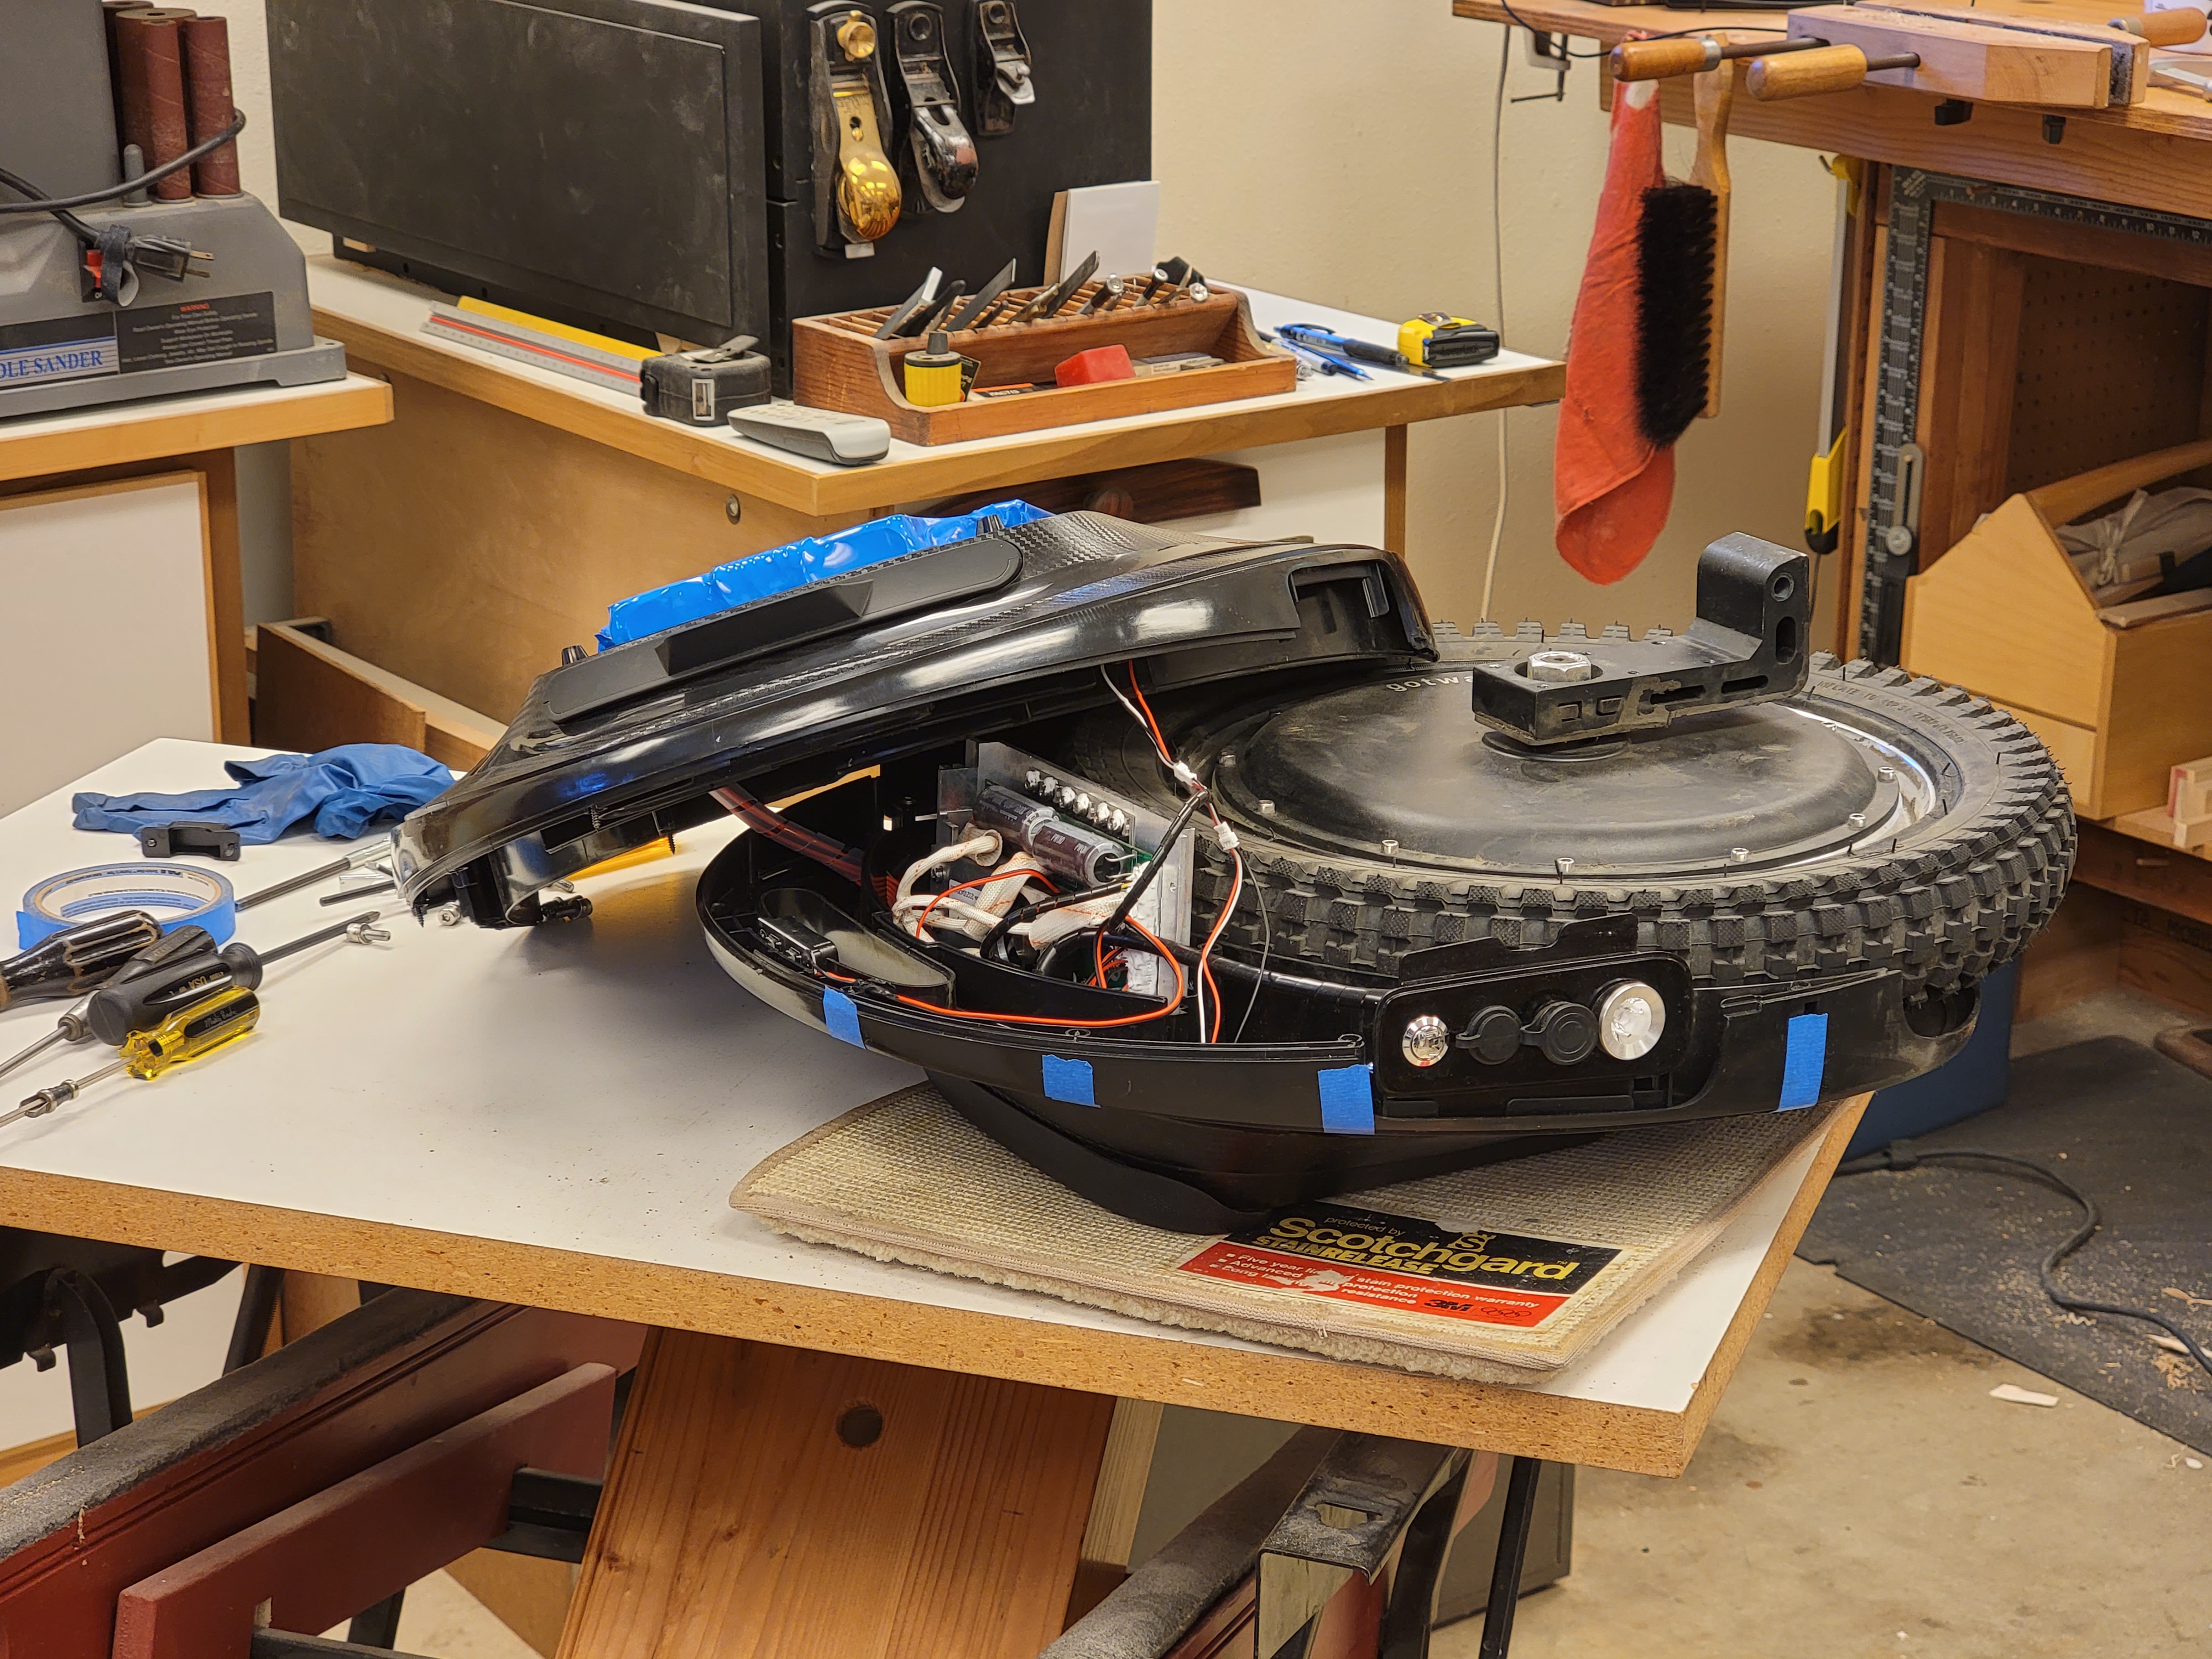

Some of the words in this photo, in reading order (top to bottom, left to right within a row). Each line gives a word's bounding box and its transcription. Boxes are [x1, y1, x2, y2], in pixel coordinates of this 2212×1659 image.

[34, 350, 103, 374] SANDER
[188, 975, 208, 989] USA
[1324, 1217, 1387, 1232] protected
[1388, 1228, 1406, 1237] by
[1270, 1217, 1580, 1280] Scotchgard
[1222, 1265, 1259, 1277] Long
[1341, 1288, 1417, 1305] resistance
[1229, 1260, 1305, 1278] Advanced
[1342, 1281, 1418, 1298] protection
[1238, 1254, 1269, 1265] Five
[1269, 1261, 1305, 1271] year
[1356, 1277, 1392, 1287] stain
[1394, 1283, 1471, 1300] protection
[1474, 1295, 1540, 1308] warranty
[1424, 1299, 1474, 1312] 3M
